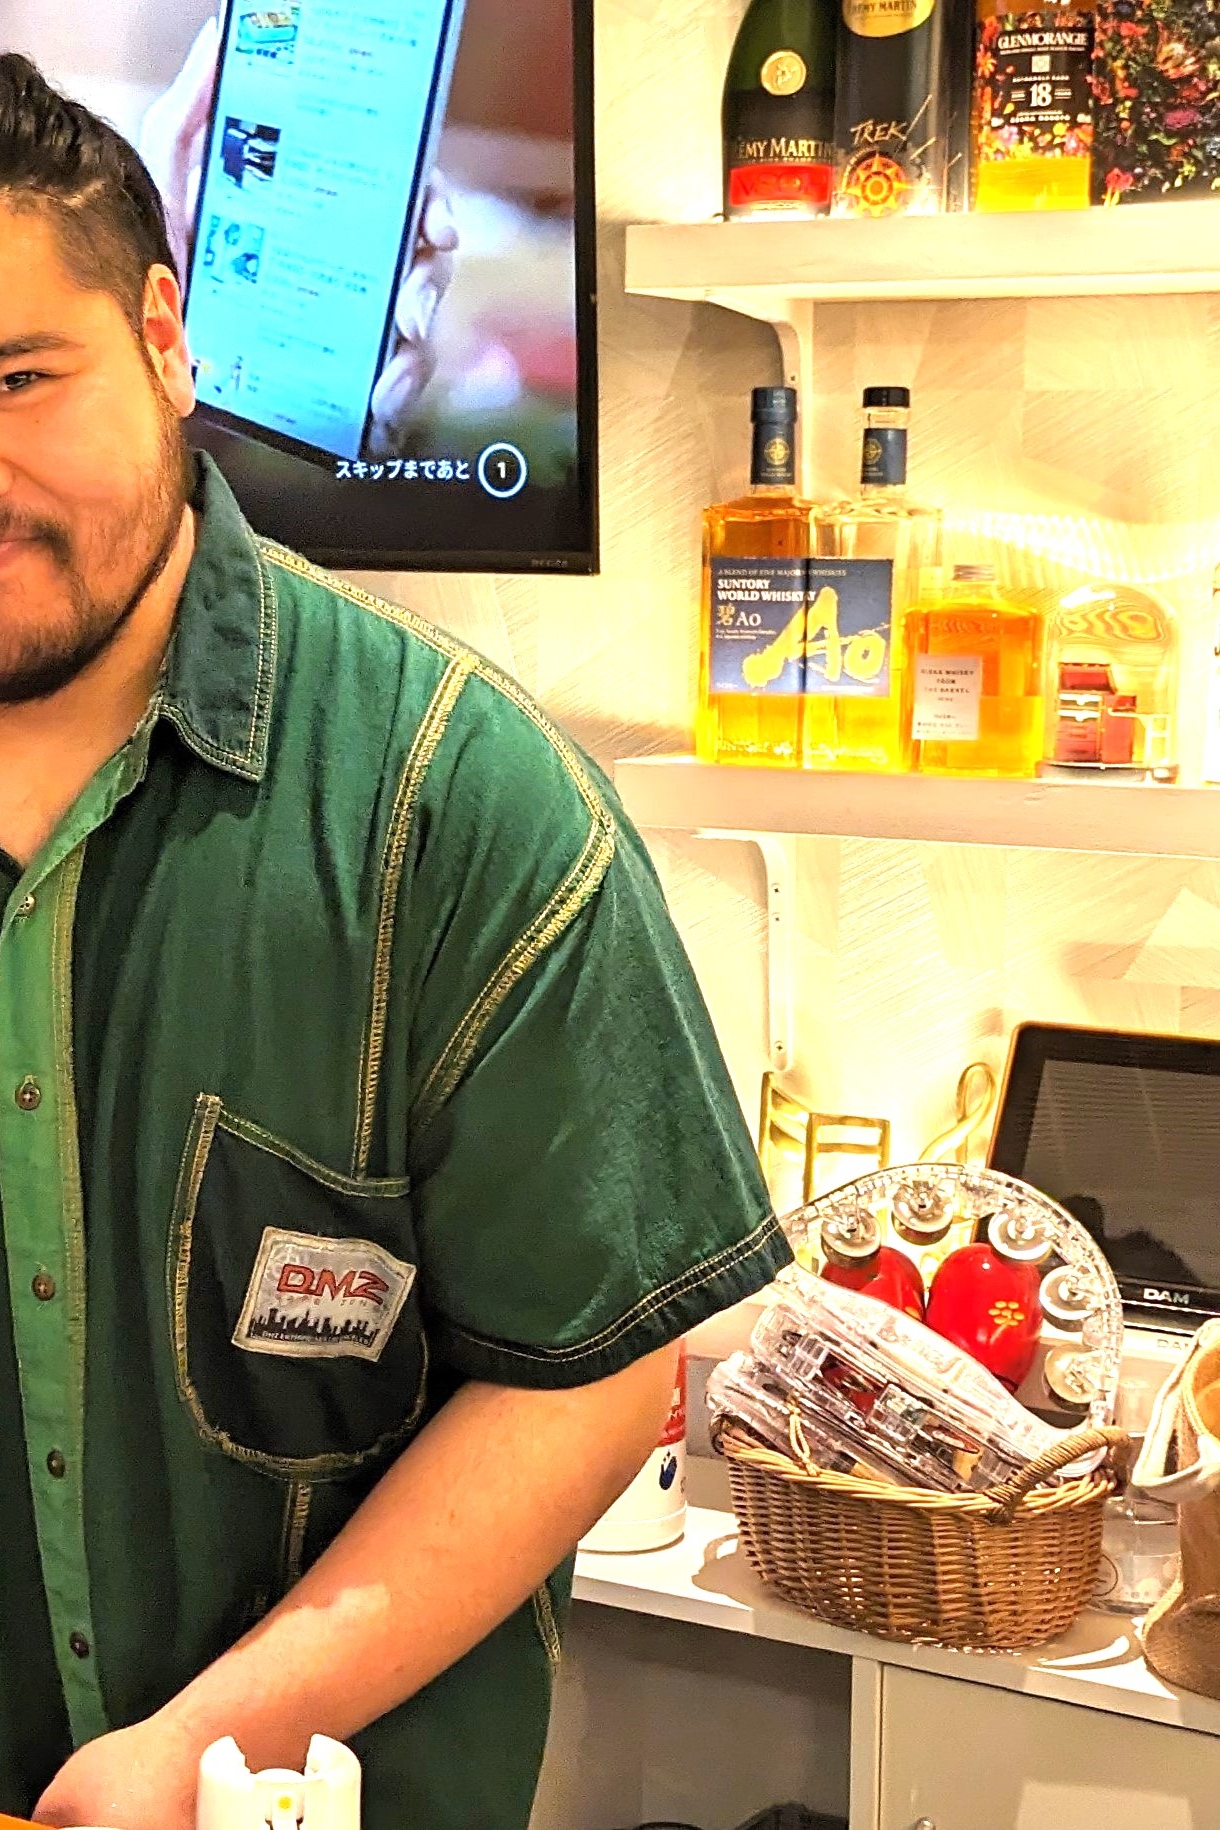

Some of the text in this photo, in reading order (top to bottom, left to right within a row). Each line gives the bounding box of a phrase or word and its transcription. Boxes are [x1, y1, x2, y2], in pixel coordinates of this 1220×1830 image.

[997, 31, 1088, 50] GLENMORANGIE
[1029, 82, 1052, 107] 18
[335, 459, 507, 480] スキップまであと 1
[717, 579, 771, 590] SUNTORY
[717, 591, 760, 602] WORLD
[276, 1263, 390, 1306] DMZ
[1143, 1287, 1190, 1305] DAM
